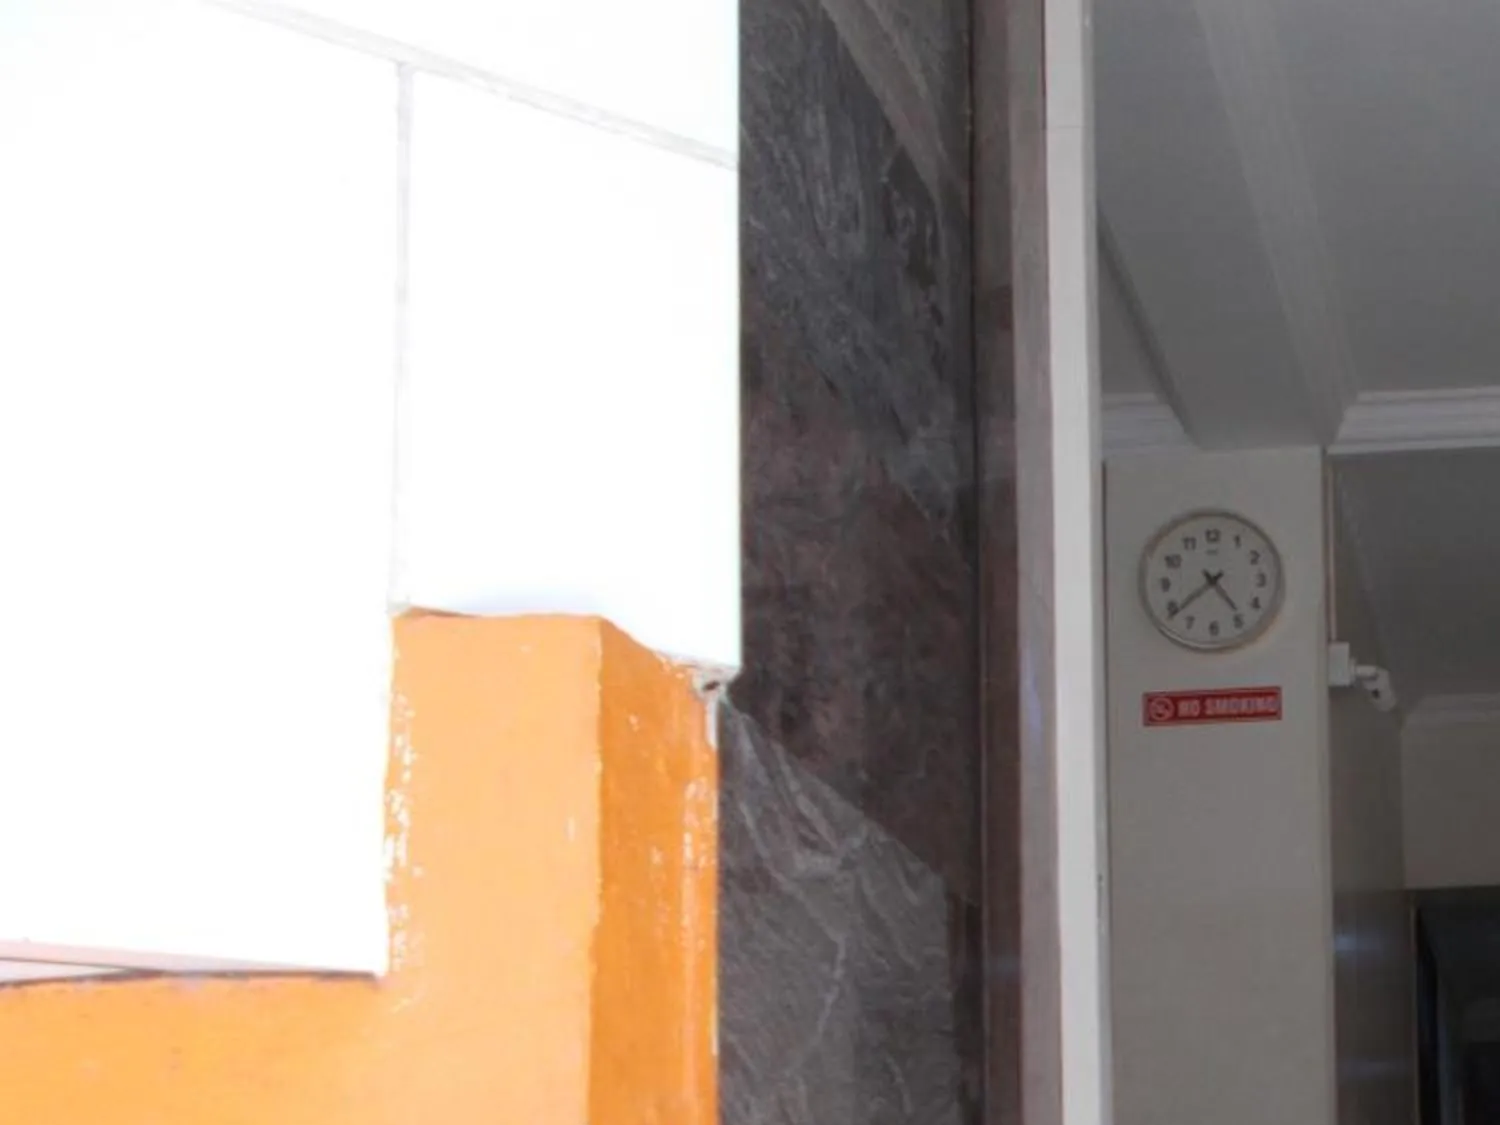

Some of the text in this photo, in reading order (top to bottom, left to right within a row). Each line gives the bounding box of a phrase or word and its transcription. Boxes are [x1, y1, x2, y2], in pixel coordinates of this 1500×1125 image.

[1182, 536, 1197, 550] 11
[1205, 528, 1221, 543] 12
[1233, 534, 1242, 548] 1
[1164, 554, 1182, 569] 10
[1249, 550, 1261, 565] 2
[1256, 573, 1267, 588] 3
[1251, 597, 1261, 610] 4
[1184, 616, 1196, 630] 7
[1208, 621, 1220, 636] 6
[1177, 694, 1278, 717] NO SMOKING
